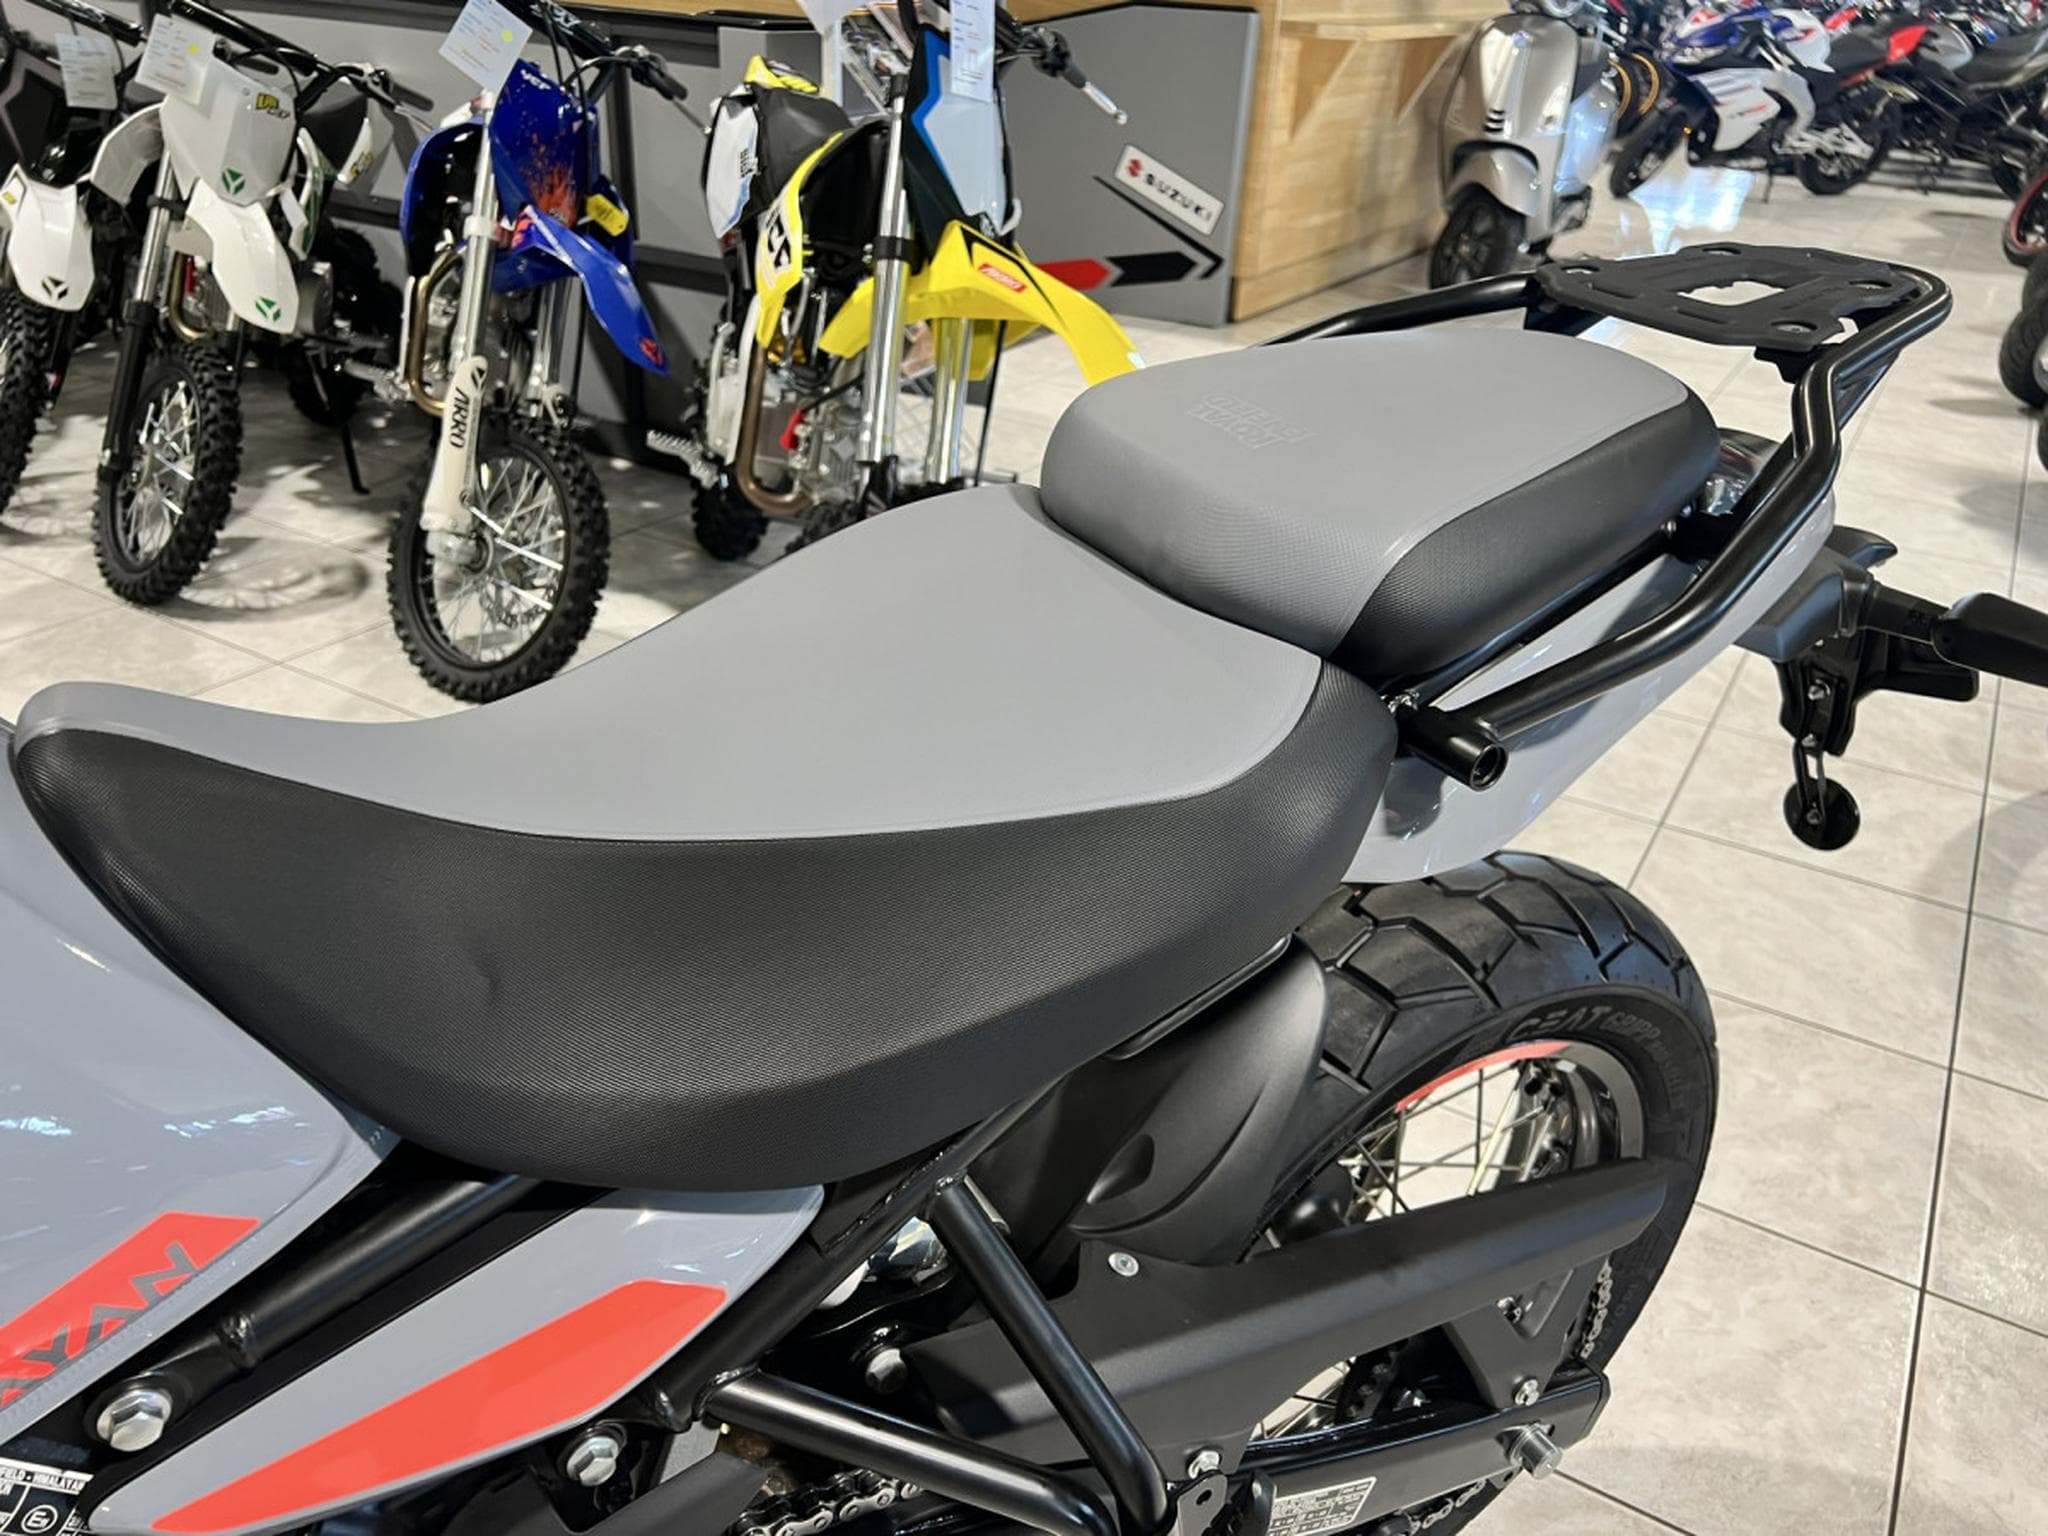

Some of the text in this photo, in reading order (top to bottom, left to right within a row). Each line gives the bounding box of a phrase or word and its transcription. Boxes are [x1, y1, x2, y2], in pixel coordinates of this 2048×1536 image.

[1146, 173, 1213, 222] SUZUKI
[449, 386, 470, 449] ARRO
[1509, 1005, 1613, 1040] CEAT
